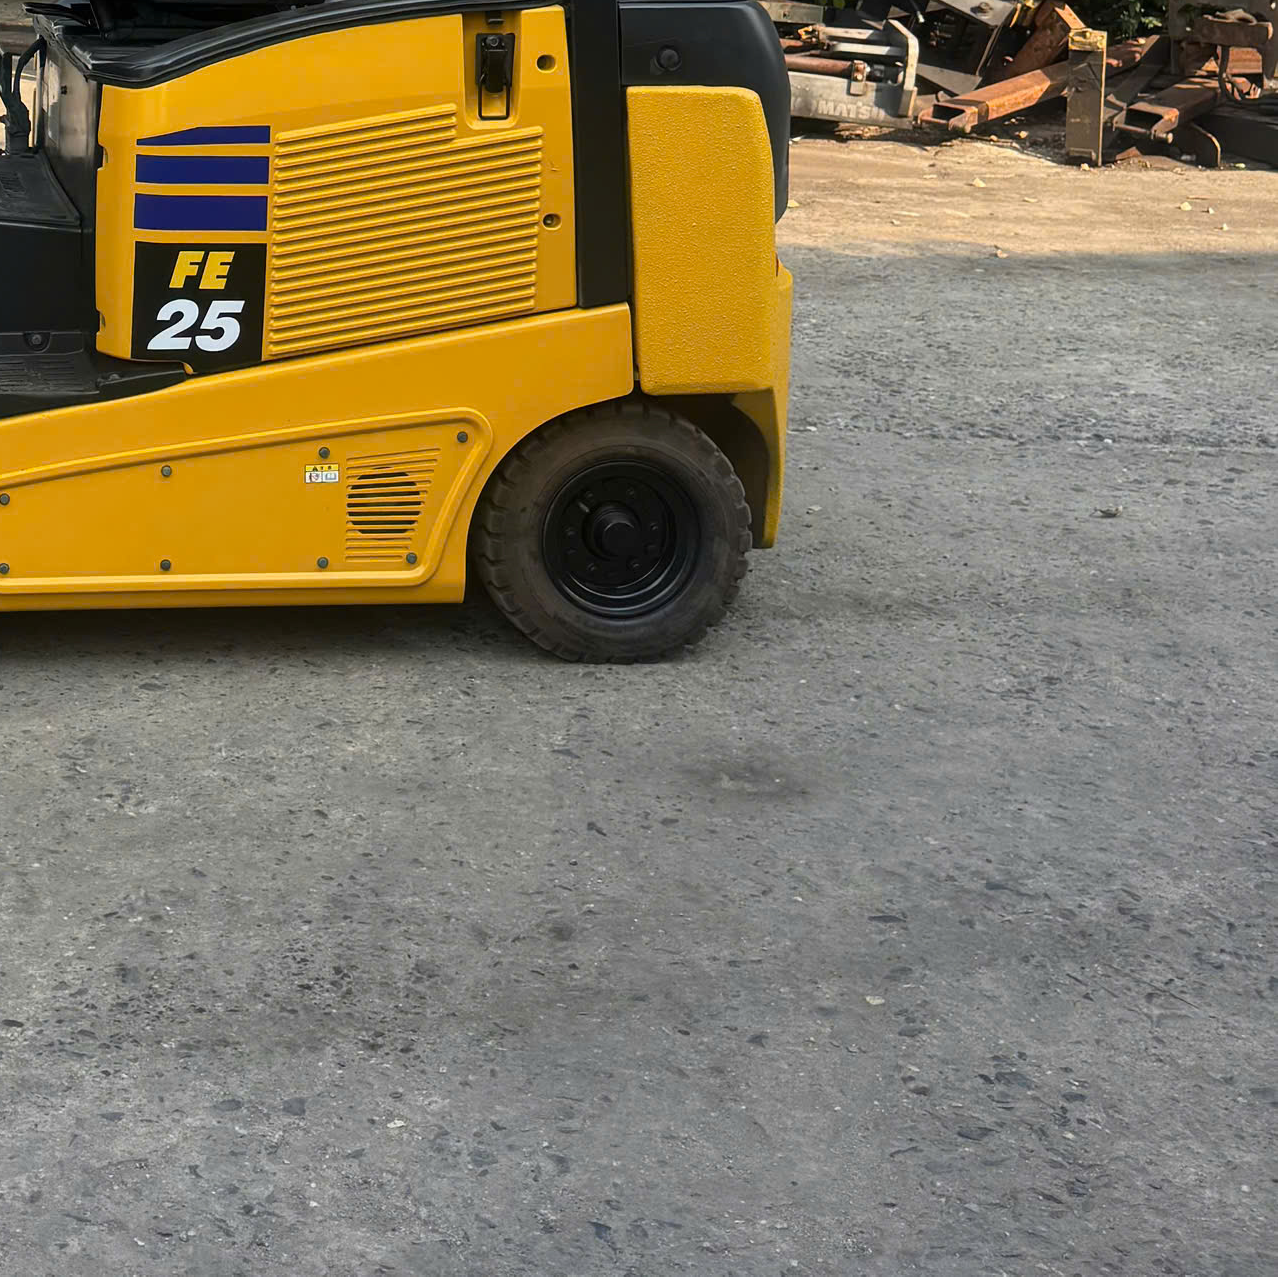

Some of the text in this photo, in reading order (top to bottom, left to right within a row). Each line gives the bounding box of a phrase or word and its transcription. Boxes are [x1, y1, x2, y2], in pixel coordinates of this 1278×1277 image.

[793, 98, 886, 120] MATSU
[169, 251, 235, 290] FE
[147, 299, 245, 352] 25
